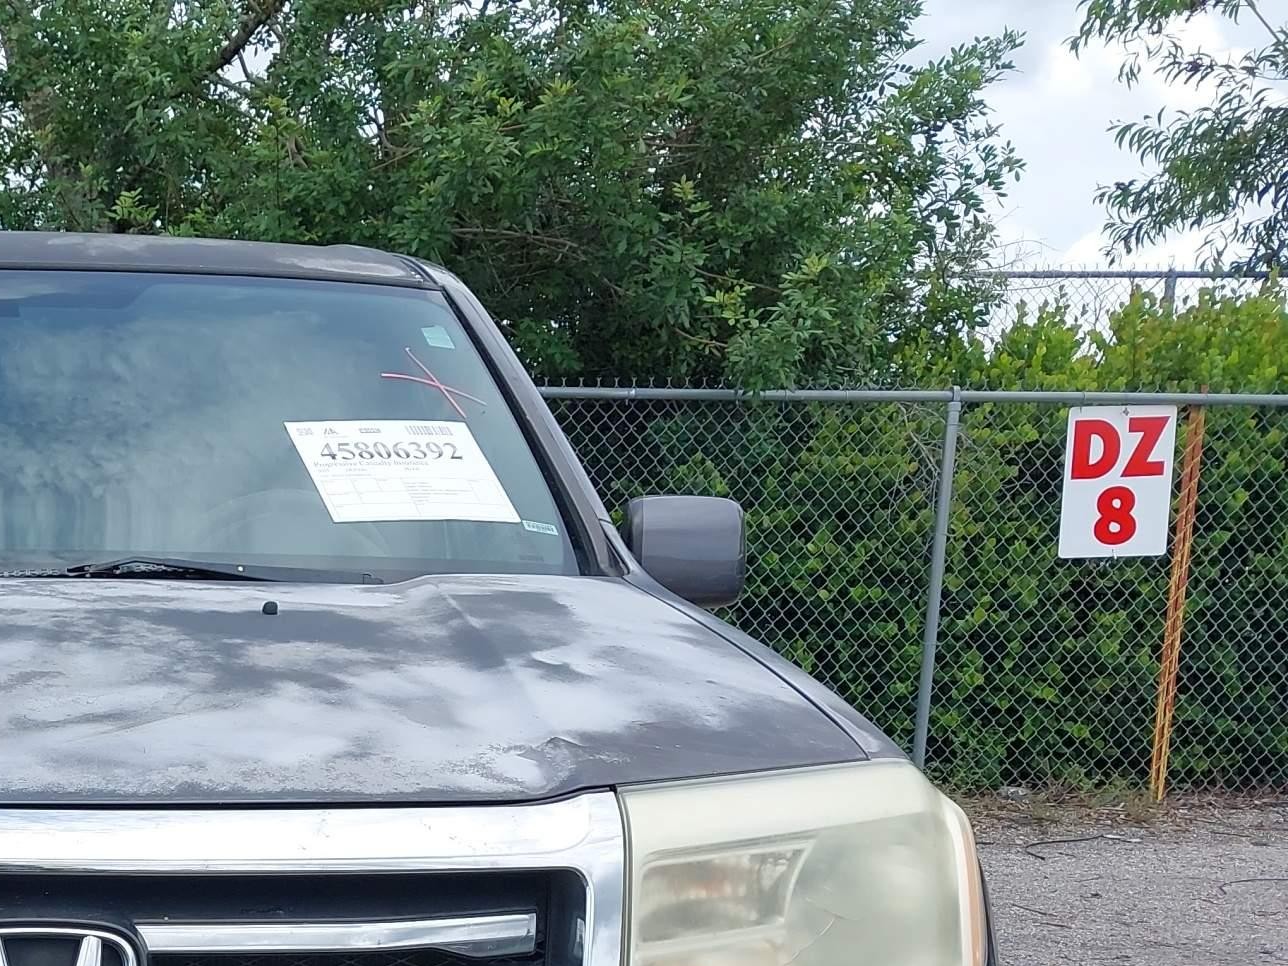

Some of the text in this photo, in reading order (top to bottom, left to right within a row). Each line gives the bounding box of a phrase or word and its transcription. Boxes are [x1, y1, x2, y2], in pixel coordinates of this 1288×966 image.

[320, 441, 464, 461] 45806392
[1070, 416, 1171, 480] DZ
[1093, 486, 1137, 546] 8
